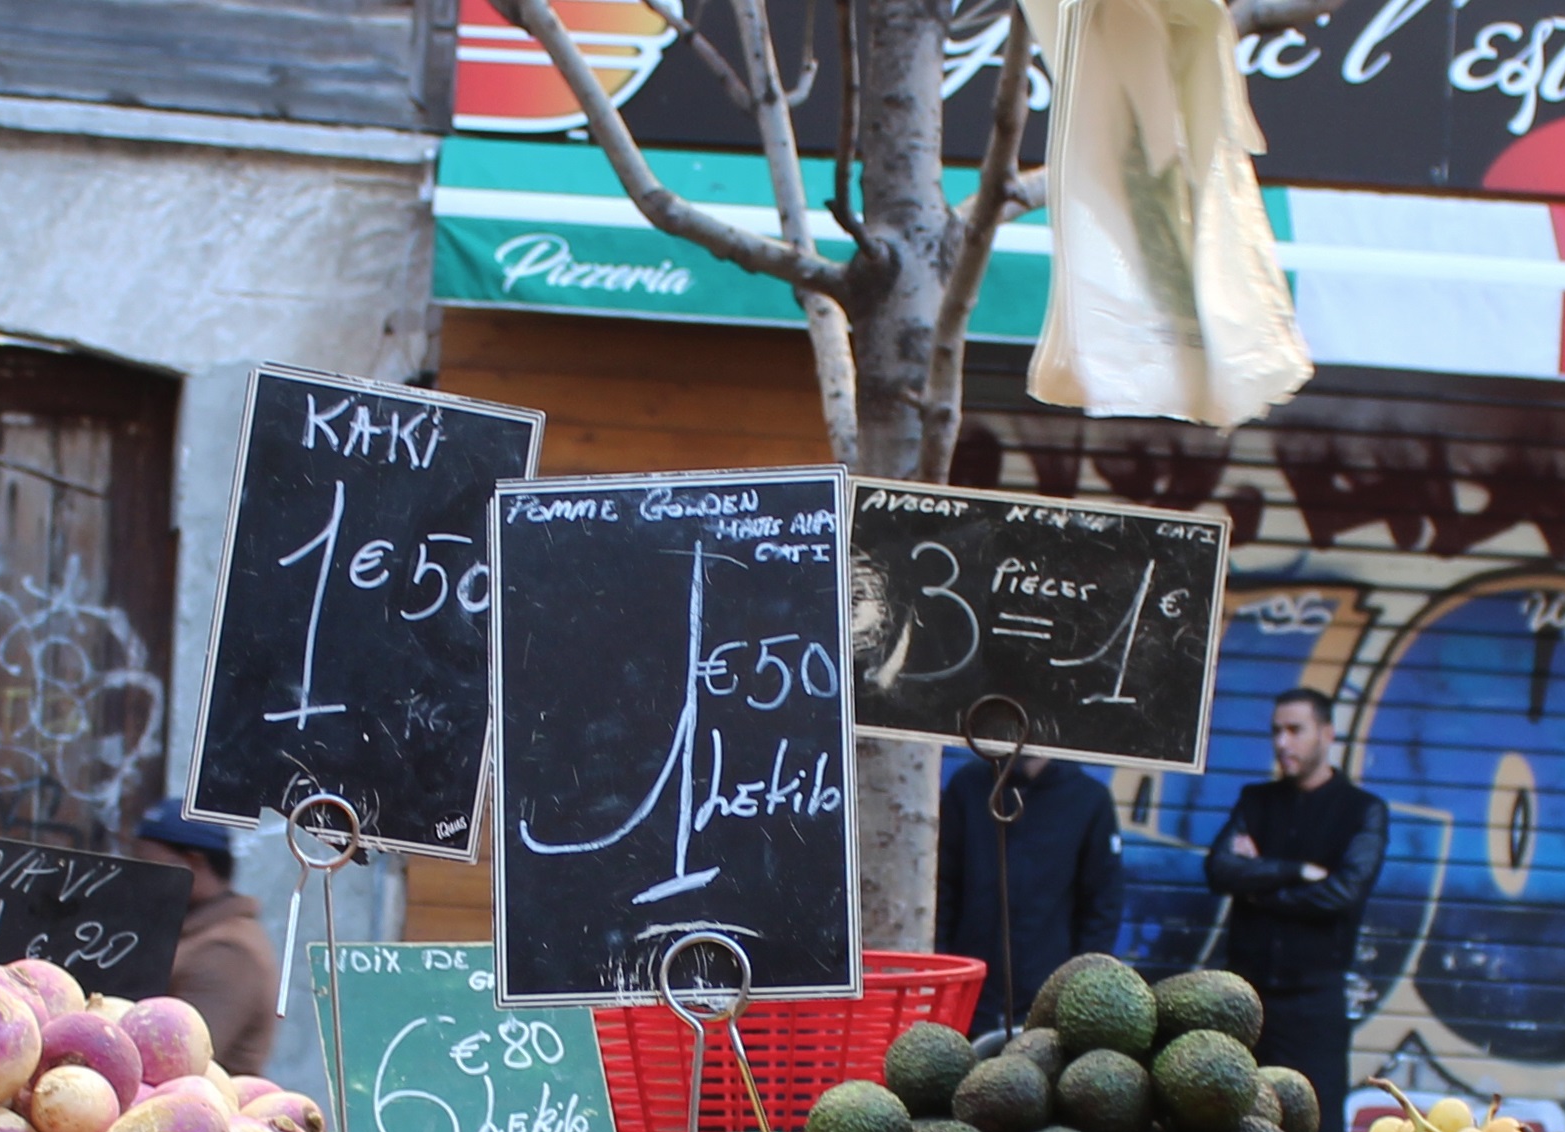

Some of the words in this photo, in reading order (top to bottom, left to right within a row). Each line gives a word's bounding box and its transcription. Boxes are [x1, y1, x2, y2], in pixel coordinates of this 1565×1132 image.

[495, 232, 693, 295] Pizzeria
[860, 488, 969, 518] AVOCAT
[863, 541, 980, 684] 3
[422, 949, 469, 971] DE
